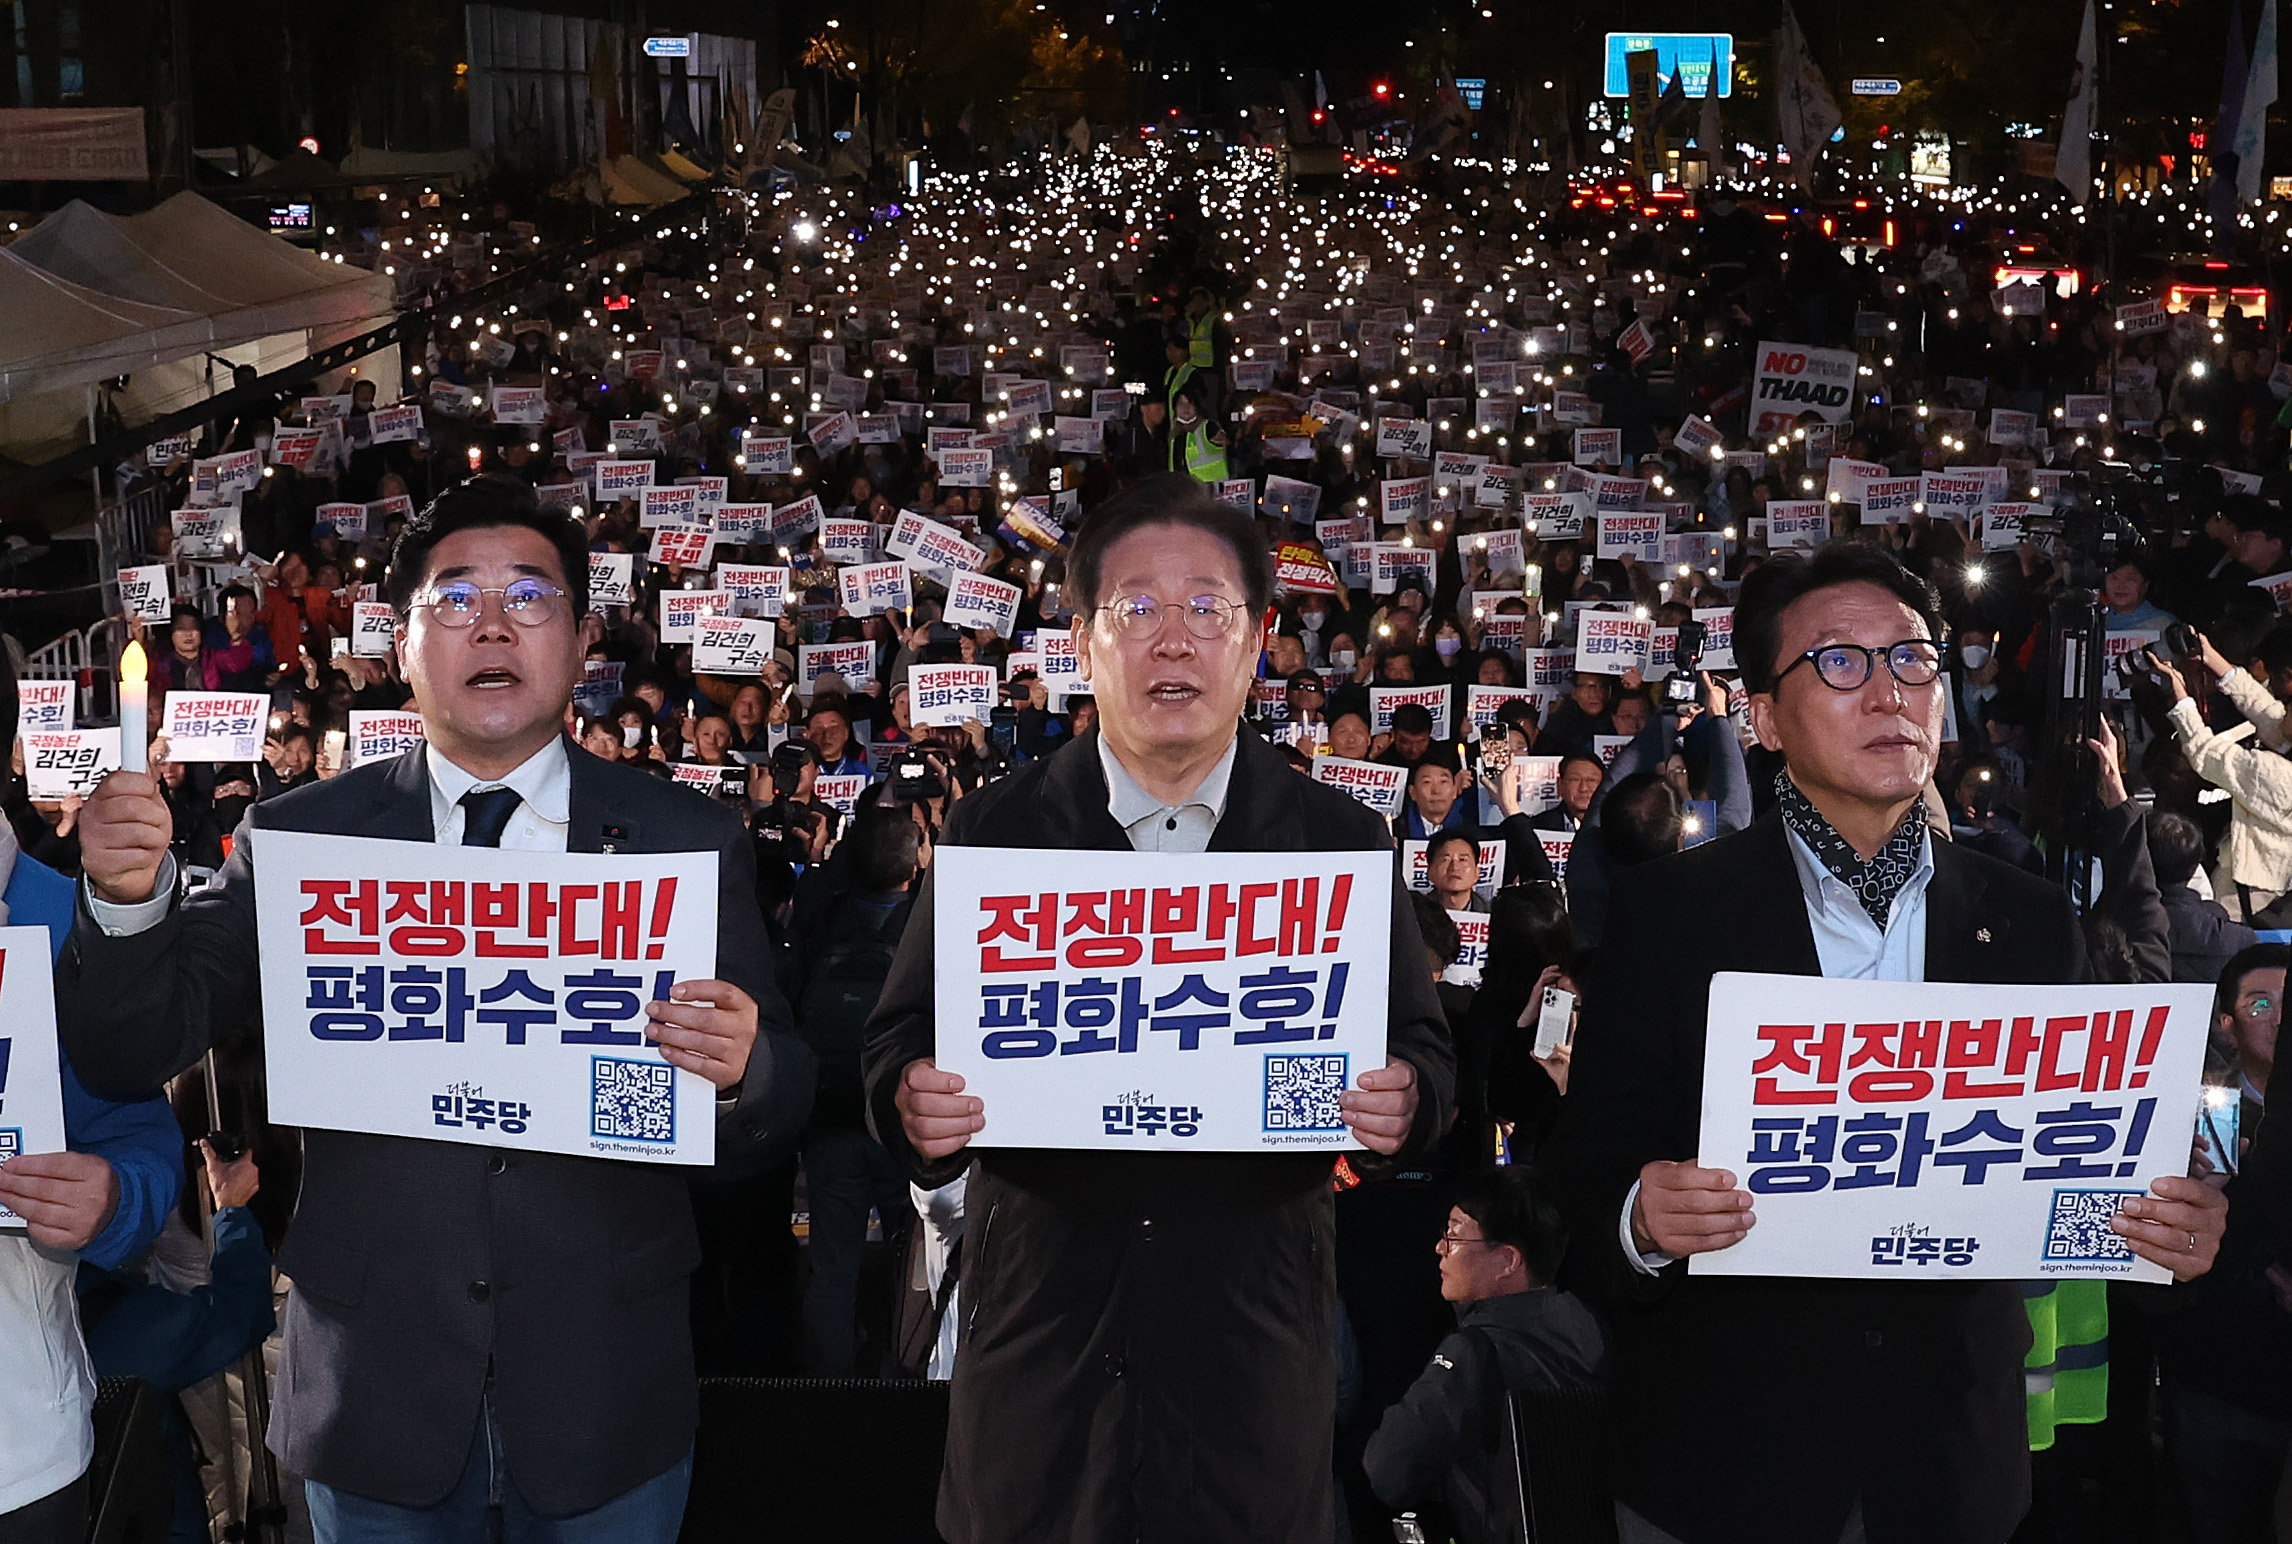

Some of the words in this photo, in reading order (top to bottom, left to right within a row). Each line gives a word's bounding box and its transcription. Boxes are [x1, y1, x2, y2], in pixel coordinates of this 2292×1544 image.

[1763, 352, 1807, 375] NO
[1760, 378, 1849, 407] THAAD
[1383, 428, 1419, 441] 김건희
[1440, 462, 1477, 475] 김건희
[700, 479, 722, 490] 반대!
[1927, 478, 1984, 493] 전쟁반대!
[646, 489, 695, 502] 전쟁반대!
[718, 507, 766, 519] 전쟁반대!
[1532, 505, 1574, 519] 김건희
[825, 524, 874, 537] 전쟁반대!
[1604, 516, 1660, 532] 전쟁반대!
[1990, 515, 2023, 531] 김건
[1488, 532, 1517, 545] 반대!
[1378, 552, 1430, 568] 전쟁반대!
[724, 571, 783, 585] 전쟁반대!
[725, 586, 782, 599] 화수호!
[847, 583, 904, 603] 평수호!
[957, 578, 1016, 602] 전쟁반대!
[954, 593, 1013, 618] 평화수호!
[362, 617, 395, 633] 김건
[699, 618, 742, 631] 국정농단
[1587, 619, 1650, 639] 전쟁반대!
[701, 631, 754, 650] 김건희
[727, 649, 769, 667] 구속!
[807, 645, 869, 665] 전쟁반대!
[1534, 655, 1576, 670] 전쟁반
[918, 671, 989, 691] 전쟁반대!
[19, 686, 66, 704] 반대!
[918, 688, 989, 708] 평화수호!
[1378, 689, 1444, 711] 전쟁반대!
[22, 706, 65, 724] 수호!
[174, 700, 260, 719] 전쟁반대!
[172, 719, 257, 739] 평화수호!
[359, 718, 424, 738] 전쟁반
[29, 734, 81, 748] 국정농단
[360, 737, 422, 757] 평화수
[35, 749, 101, 770] 김건희
[1320, 764, 1399, 788] 전쟁반대!
[816, 779, 857, 799] 반대!
[1326, 782, 1397, 806] 화수호!
[300, 876, 679, 960] 전쟁반대!
[977, 873, 1354, 973] 전쟁반대!
[305, 964, 676, 1046] 평화수호!
[978, 962, 1350, 1060] 평화수호!
[1752, 1005, 2171, 1105] 전쟁반대!
[432, 1094, 532, 1134] 민주당
[1102, 1104, 1203, 1137] 민주당
[589, 1139, 676, 1156] sign.theminjoo.kr
[1261, 1133, 1347, 1146] sign.theminjoo.kr
[1746, 1097, 2158, 1194] 평화수호!
[1871, 1234, 1980, 1266] 민주당
[2039, 1262, 2133, 1274] sign.theminjoo.kr
